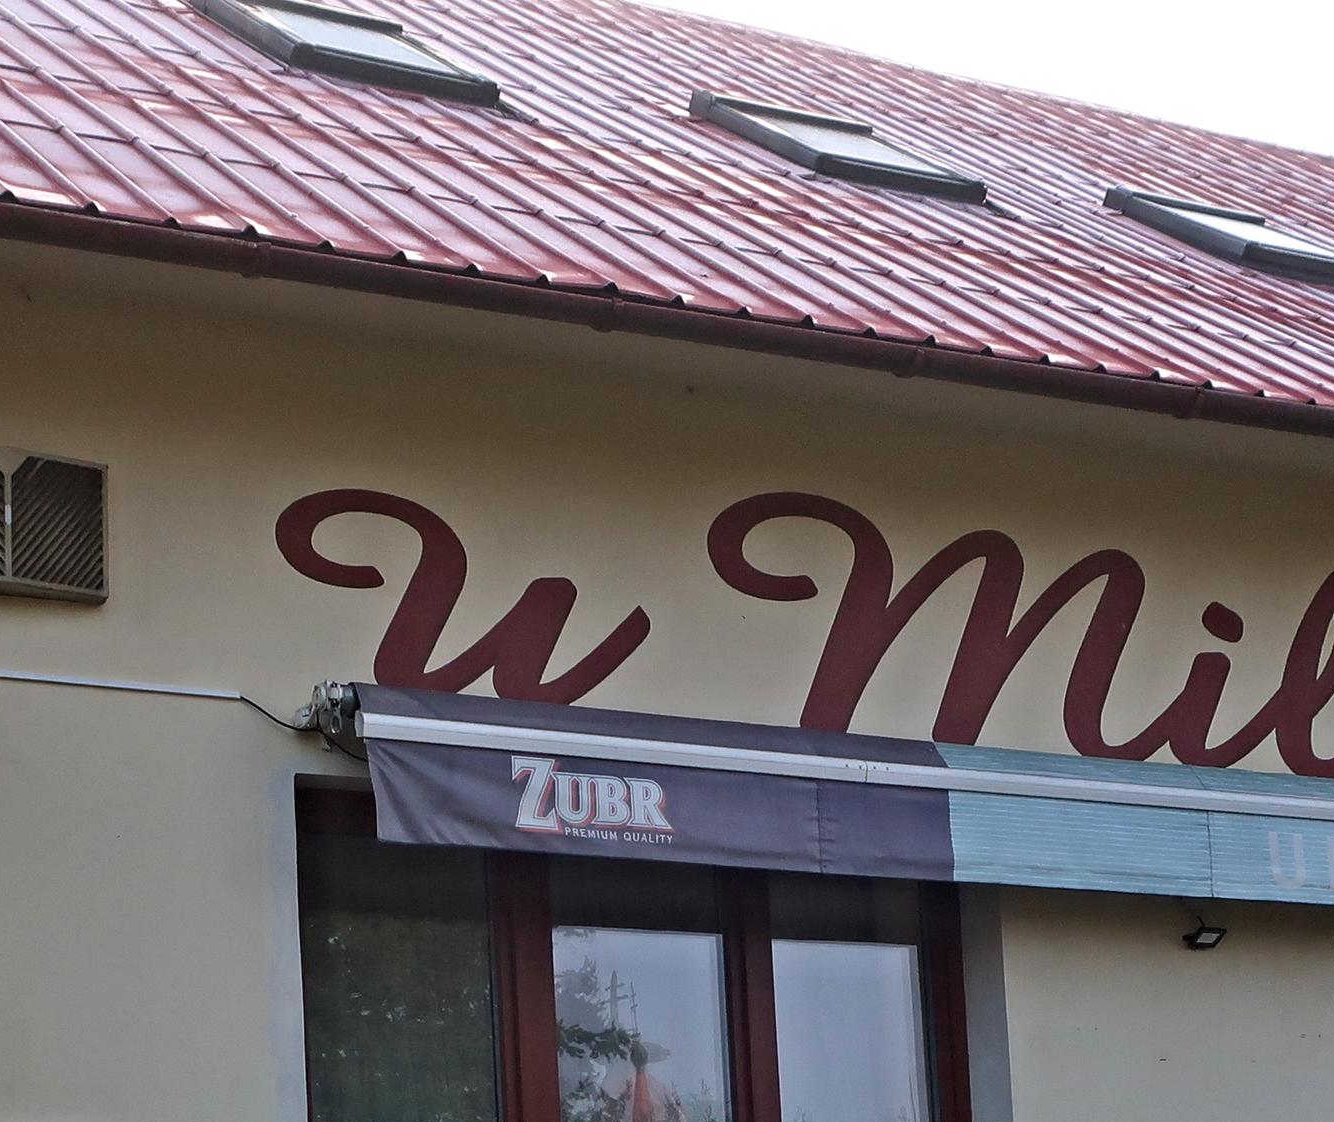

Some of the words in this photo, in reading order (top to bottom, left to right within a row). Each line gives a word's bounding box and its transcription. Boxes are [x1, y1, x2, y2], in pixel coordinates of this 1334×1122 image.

[511, 755, 675, 834] ZUBR
[565, 826, 617, 841] PREMIUM
[623, 832, 673, 844] QUALITY
[1268, 830, 1307, 888] U
